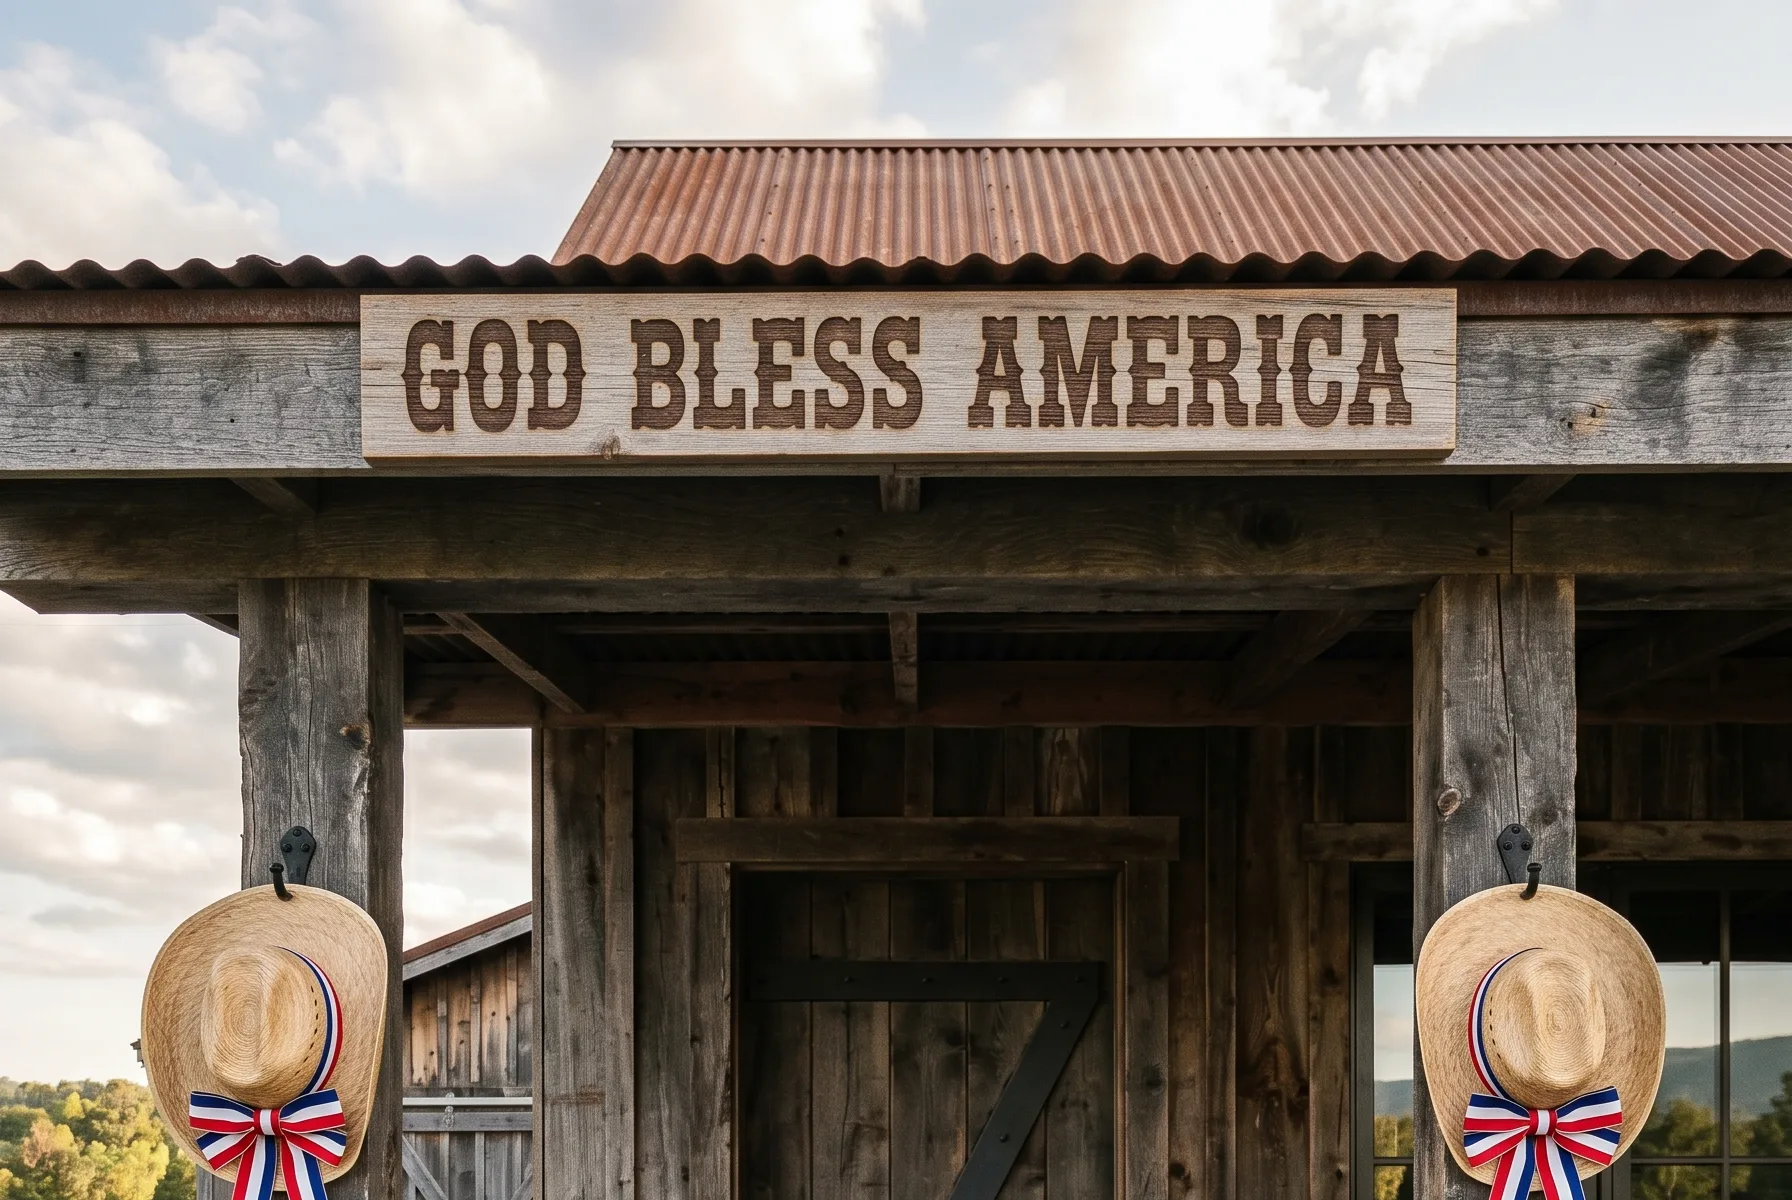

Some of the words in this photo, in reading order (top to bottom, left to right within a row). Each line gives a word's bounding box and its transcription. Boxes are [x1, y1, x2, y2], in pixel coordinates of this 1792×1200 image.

[401, 318, 587, 434] GOD
[629, 315, 923, 431] BLESS
[967, 312, 1413, 429] AMERICA
